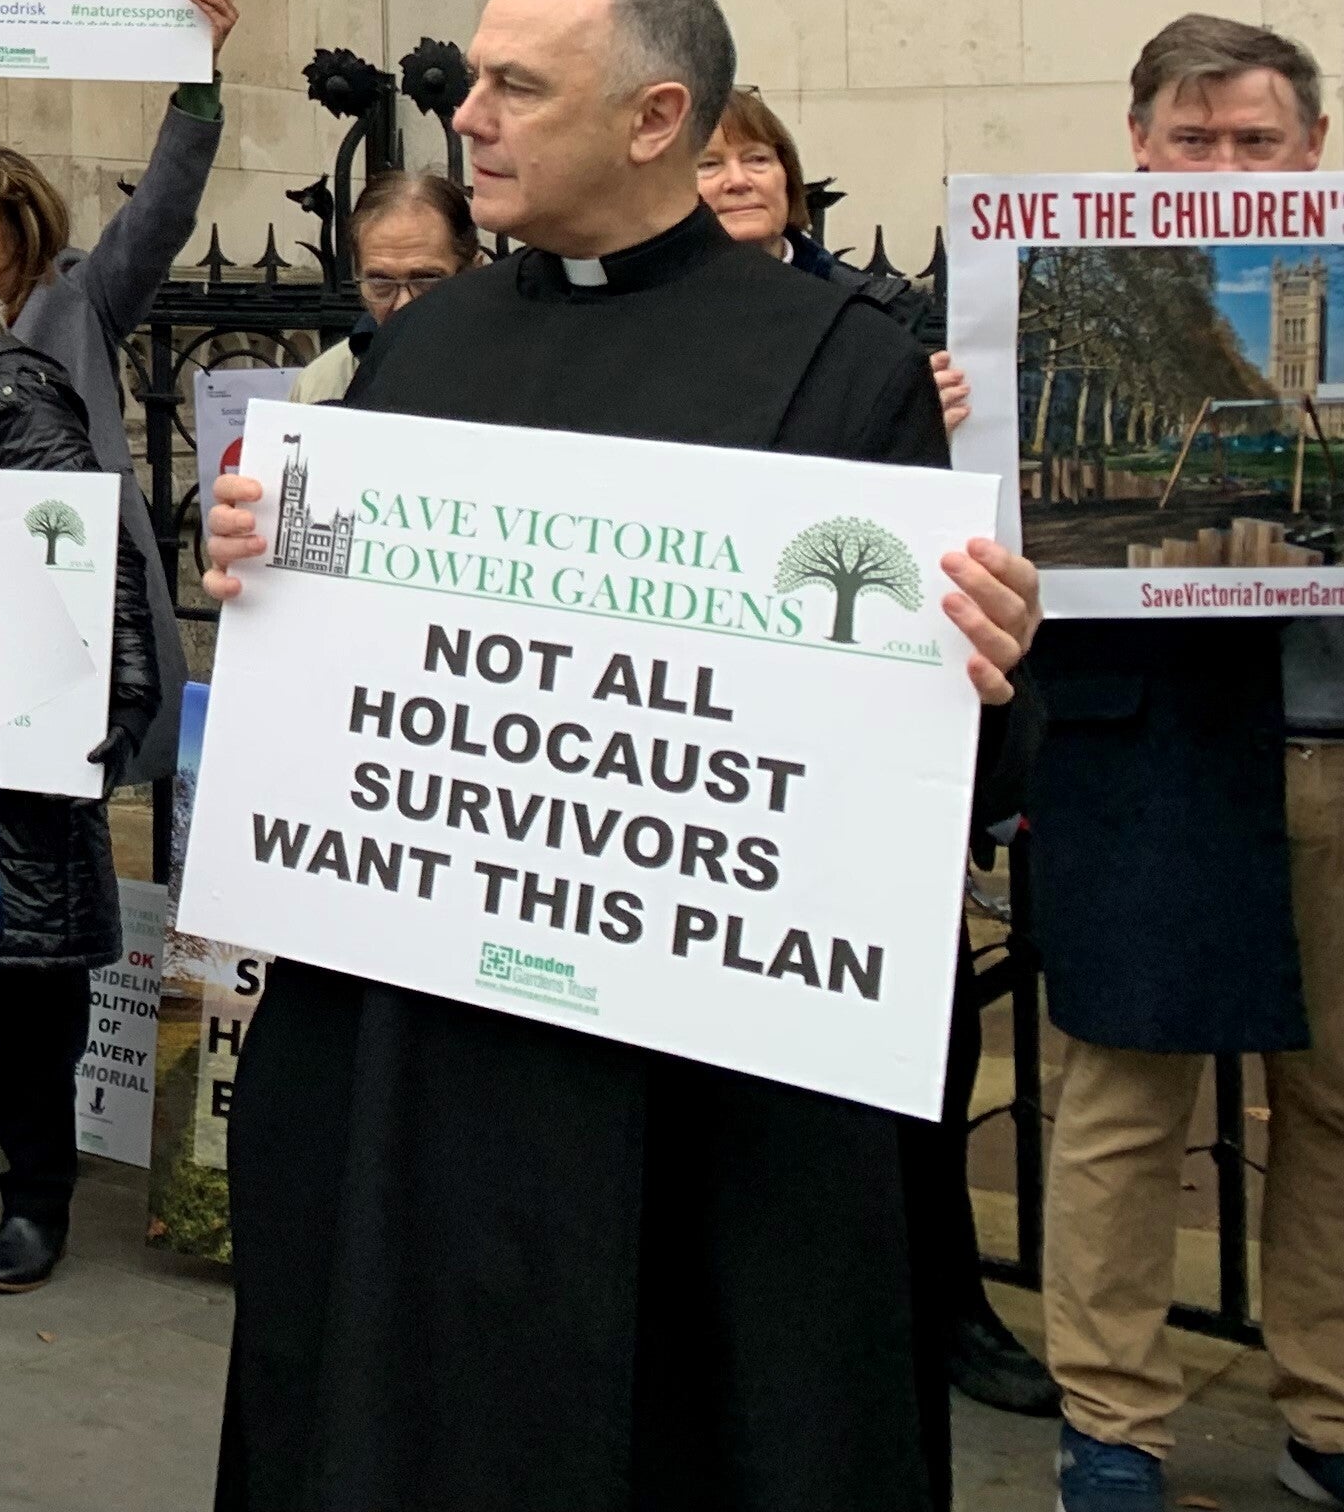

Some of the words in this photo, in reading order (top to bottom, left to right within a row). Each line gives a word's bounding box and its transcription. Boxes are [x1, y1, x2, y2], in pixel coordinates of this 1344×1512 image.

[71, 1, 197, 19] #naturessponge
[971, 192, 1061, 241] SAVE
[1072, 191, 1137, 240] THE
[1150, 189, 1344, 240] CHILDREN'
[357, 489, 477, 538] SAVE
[492, 504, 743, 574] VICTORIA
[354, 538, 535, 599] TOWER
[548, 567, 803, 638] GARDENS
[880, 639, 943, 661] .co.uk
[423, 623, 574, 692] NOT
[592, 652, 734, 722] ALL
[348, 685, 806, 813] HOLOCAUST
[350, 762, 780, 892] SURVIVORS
[252, 813, 452, 899] WANT
[474, 860, 644, 945] THIS
[671, 903, 884, 1002] PLAN
[127, 950, 156, 970] OK
[514, 949, 576, 978] London
[90, 991, 160, 1021] OLITION
[97, 1018, 122, 1036] OF
[86, 1040, 148, 1067] AVERY
